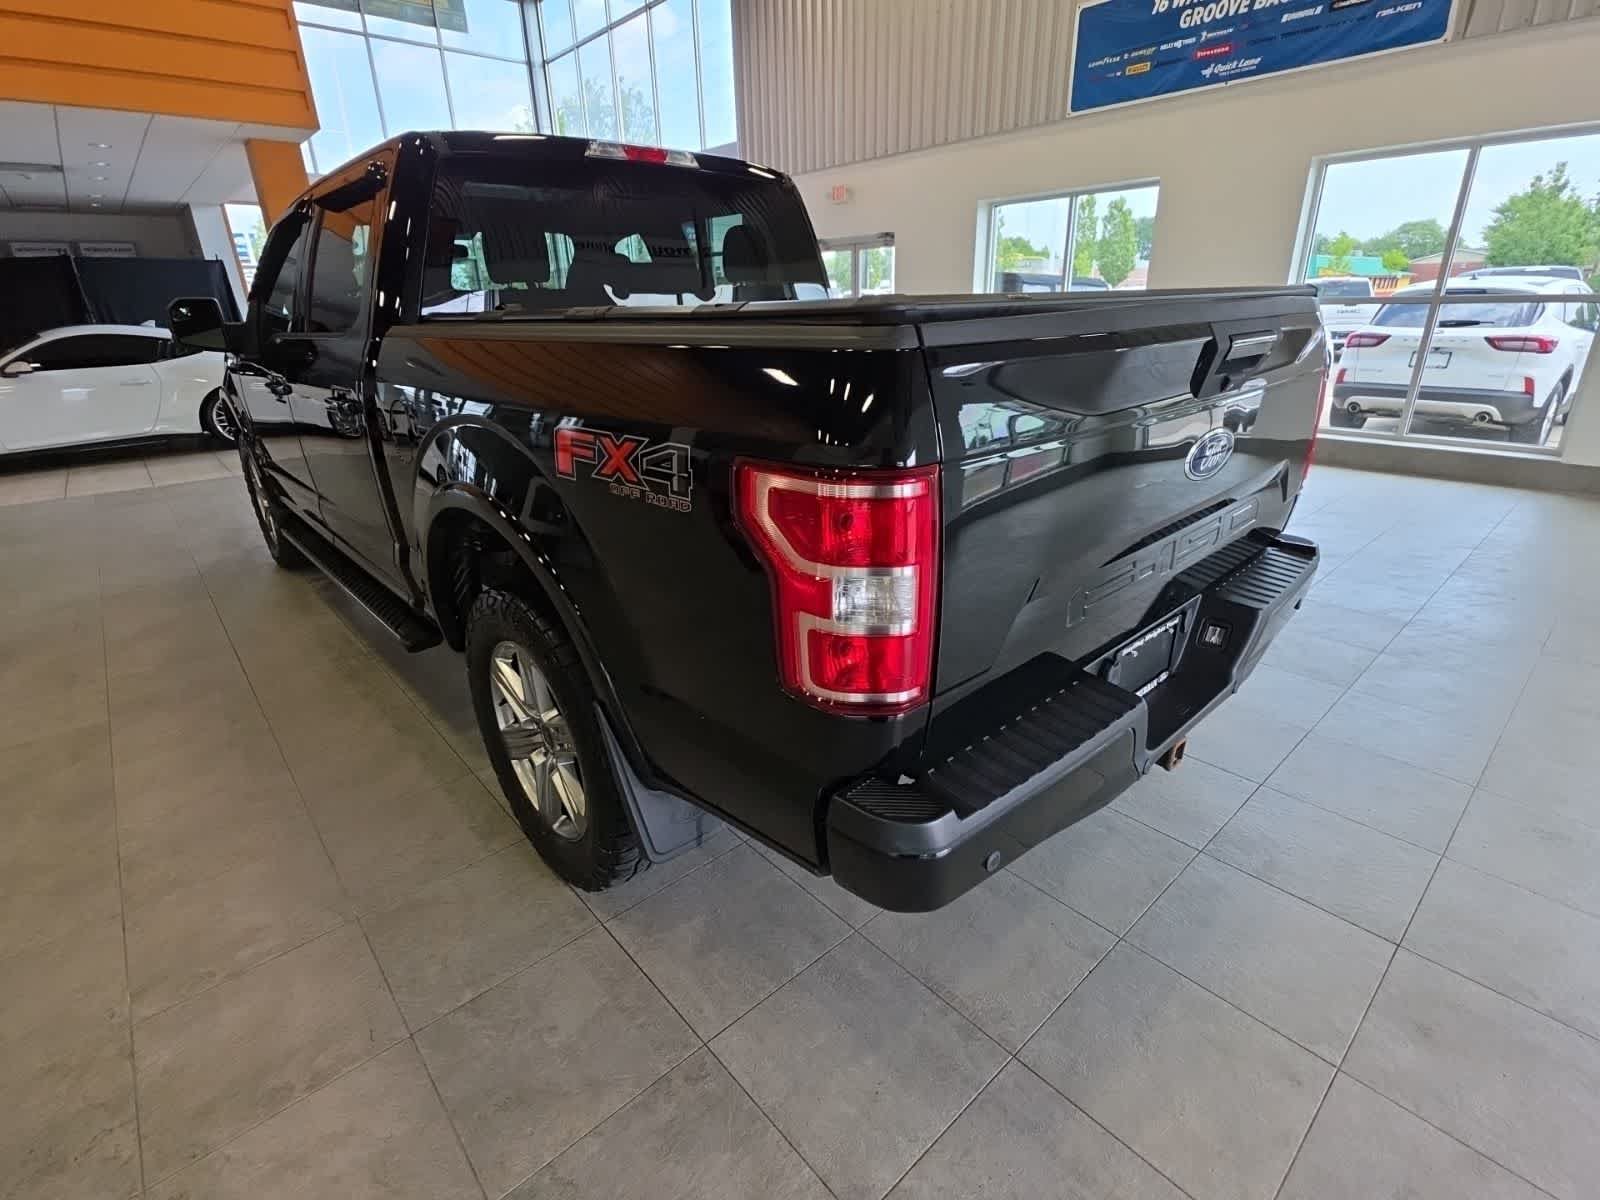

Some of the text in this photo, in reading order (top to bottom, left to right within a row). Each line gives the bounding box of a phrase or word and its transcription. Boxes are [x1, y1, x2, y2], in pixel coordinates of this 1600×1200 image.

[1179, 0, 1250, 29] GROOVE
[554, 425, 693, 501] FX4
[645, 491, 692, 513] ROAD
